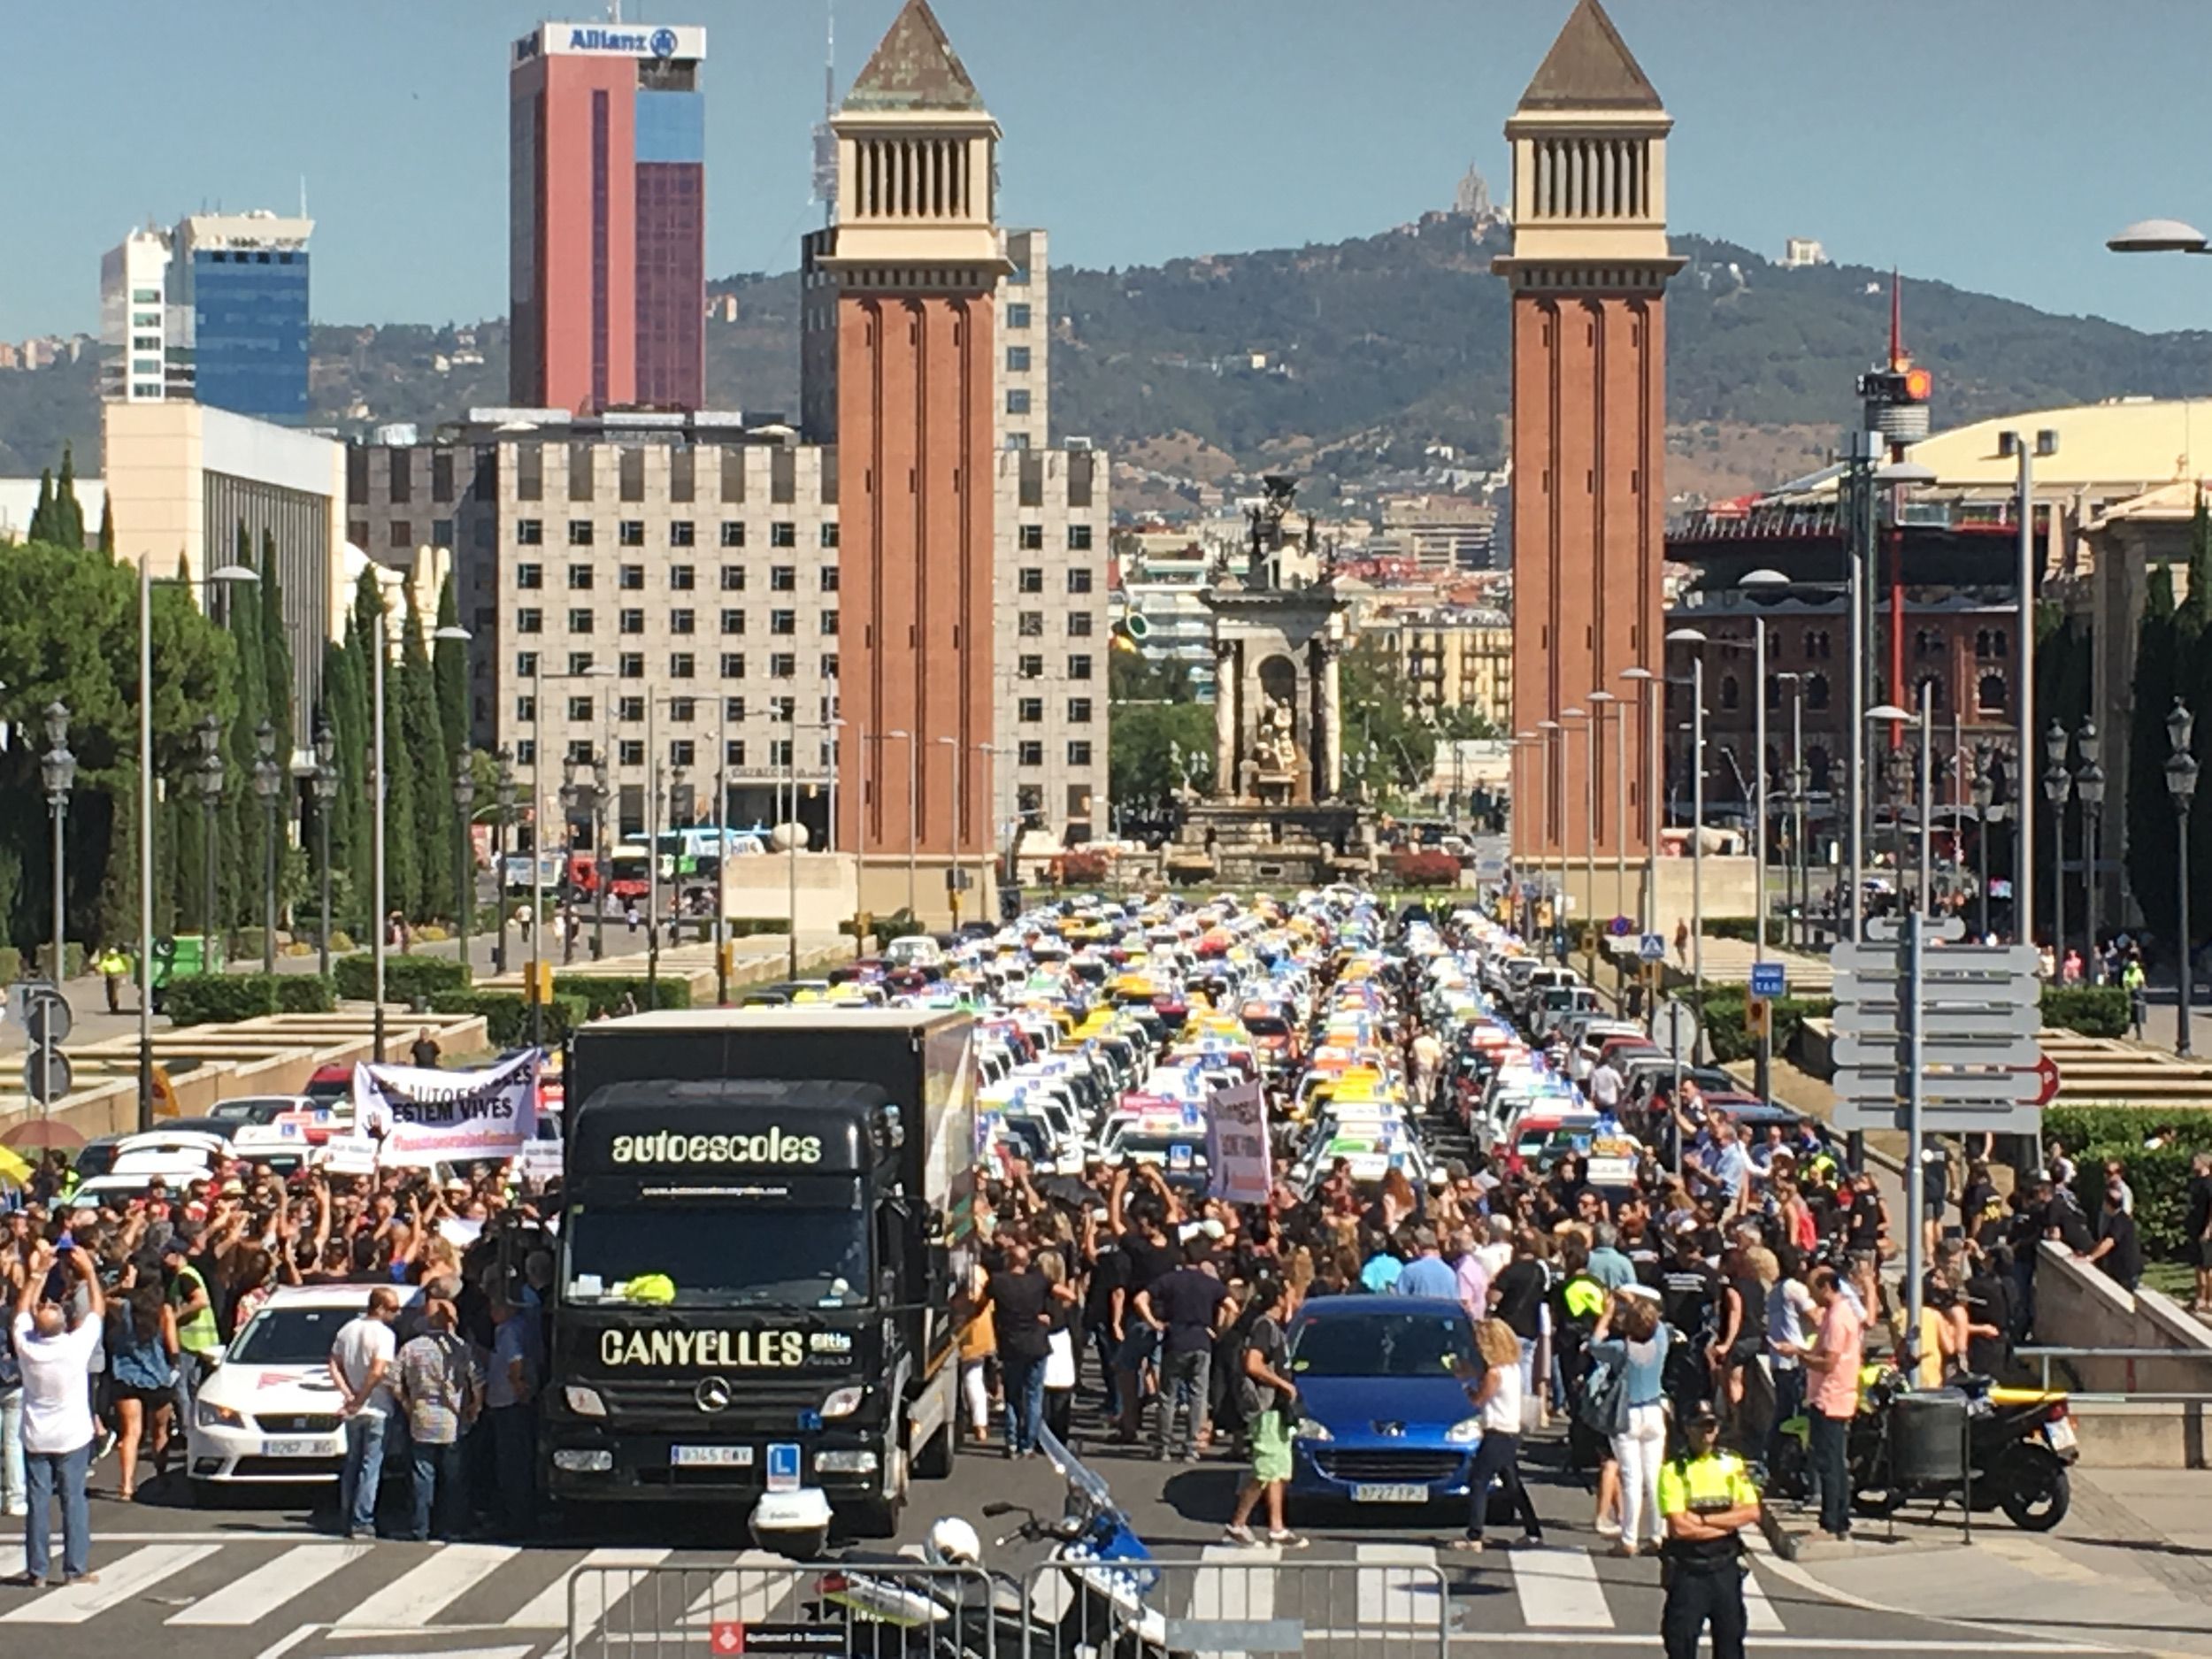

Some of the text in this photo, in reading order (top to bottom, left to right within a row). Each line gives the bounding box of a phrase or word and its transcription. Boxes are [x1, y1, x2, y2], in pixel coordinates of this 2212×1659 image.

[570, 29, 647, 51] Allianz
[392, 1097, 513, 1123] ESTEM VIVES
[611, 1126, 821, 1164] autoescoles
[601, 1329, 803, 1367] CANYELLES
[776, 1450, 791, 1473] L
